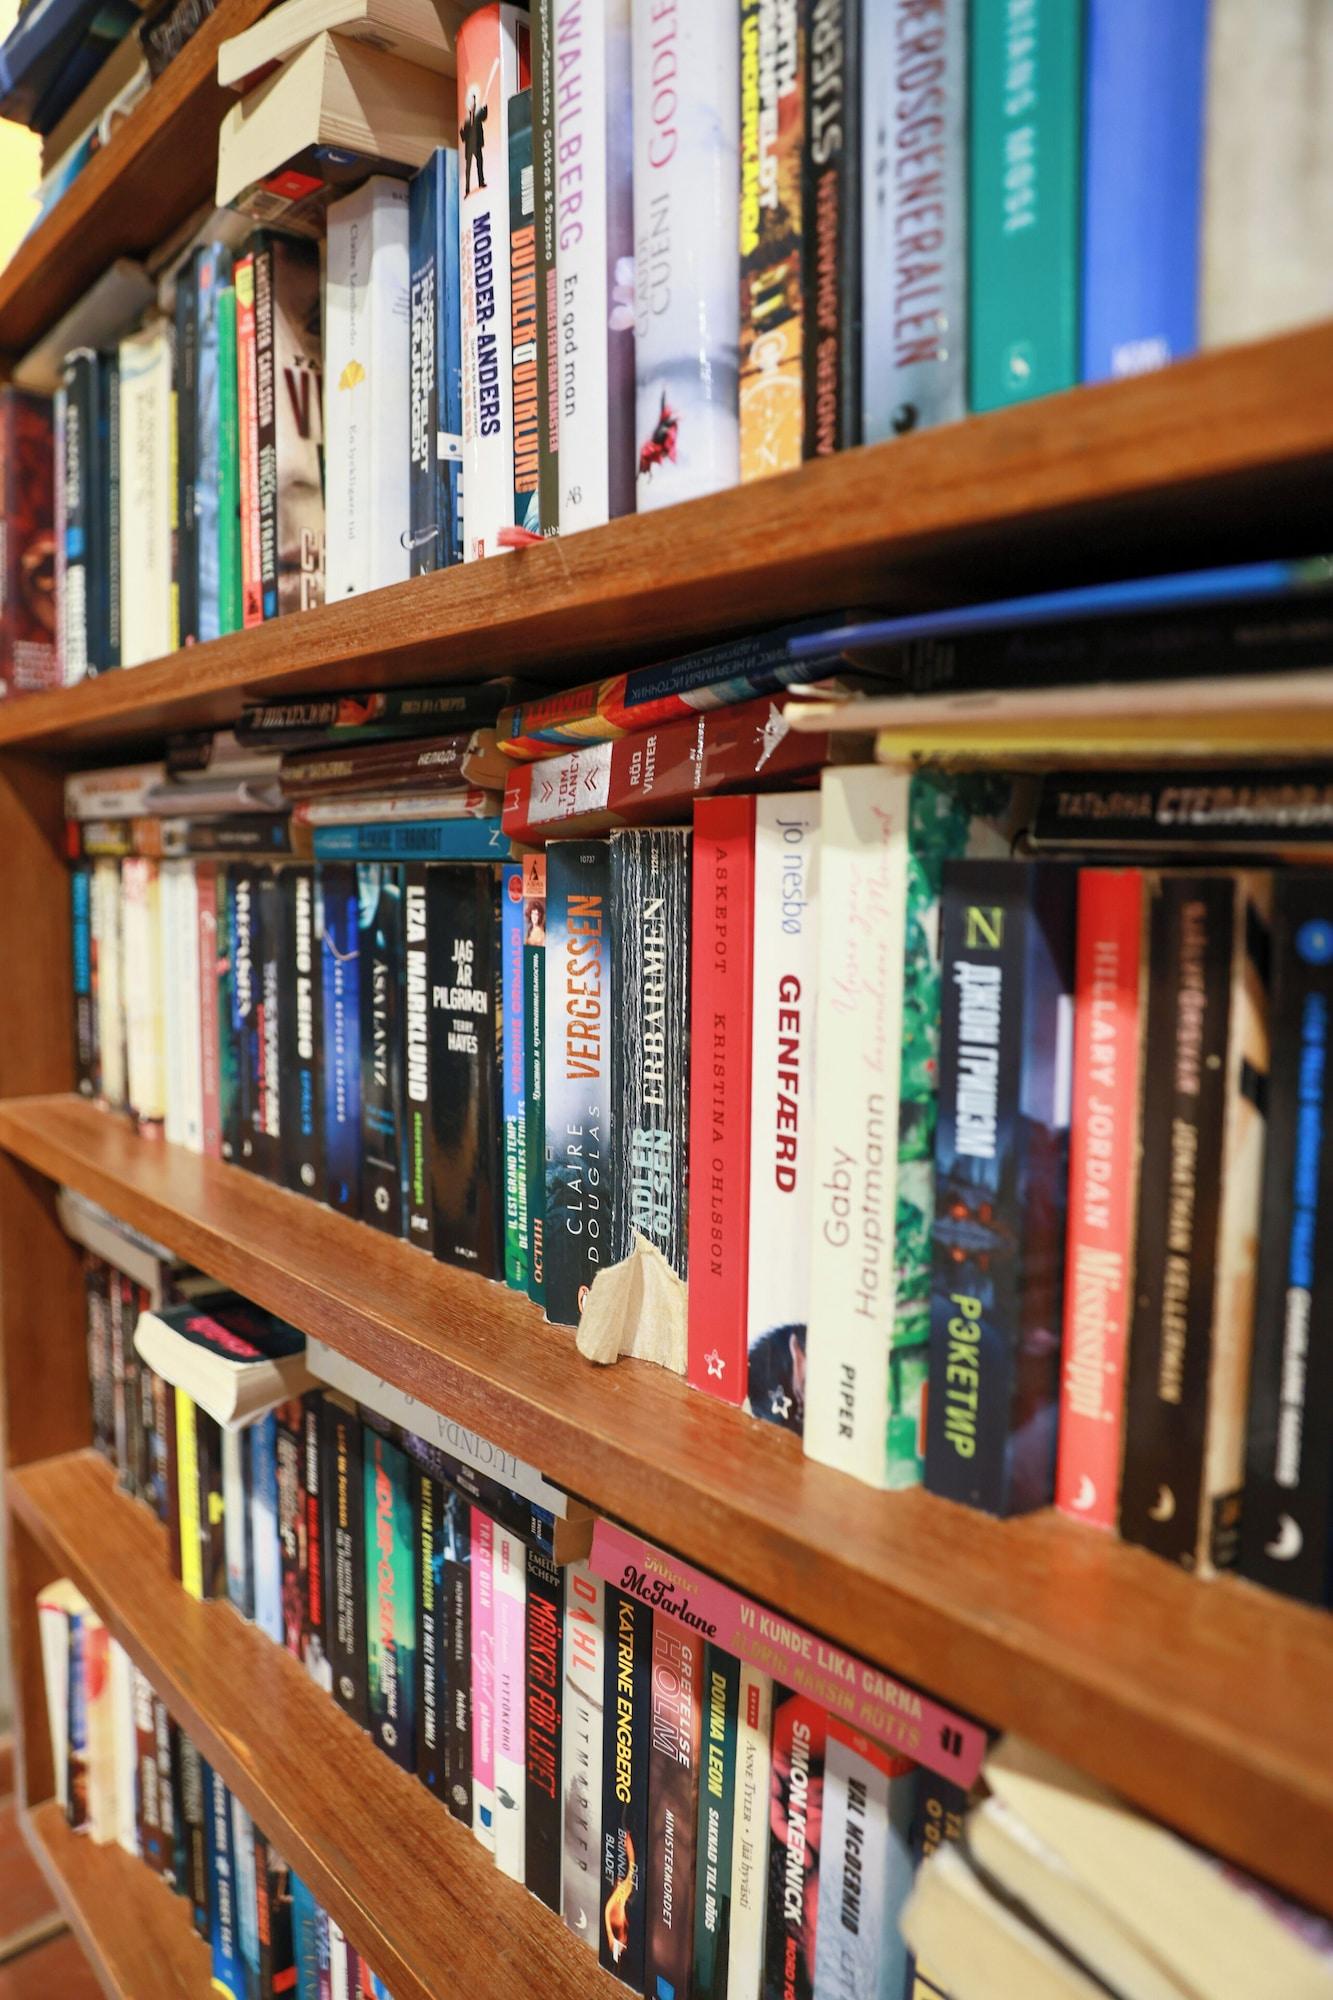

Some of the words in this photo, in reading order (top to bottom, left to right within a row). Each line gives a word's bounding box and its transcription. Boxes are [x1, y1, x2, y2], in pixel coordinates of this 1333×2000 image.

[541, 129, 553, 183] Cotton
[557, 0, 584, 251] WAHLBERG
[542, 203, 554, 261] Torneo
[649, 192, 673, 316] CUENI
[472, 211, 501, 438] MORDER-ANDERS
[562, 273, 578, 306] En
[561, 312, 579, 357] god
[562, 362, 578, 418] man
[557, 768, 570, 806] TOM
[565, 752, 581, 816] CLANCY
[628, 750, 643, 787] RÖD
[641, 734, 659, 796] VINTER
[777, 820, 810, 845] jo
[407, 885, 427, 943] LIZA
[713, 845, 728, 975] ASKEPOT
[781, 854, 809, 936] nesbø
[451, 939, 475, 963] JAG
[565, 894, 605, 1080] VERGESSEN
[297, 977, 313, 1060] LEINO
[408, 950, 428, 1101] MARKLUND
[432, 986, 489, 1014] PILGRIMEN
[452, 1018, 475, 1035] TERRY
[642, 896, 666, 1107] ERBARMEN
[952, 961, 1003, 1043] ДЖОН
[1087, 940, 1120, 1088] HILLARY
[447, 1032, 479, 1055] HAYES
[711, 1012, 726, 1144] KRISTINA
[775, 974, 802, 1194] GENFÆRD
[507, 1114, 518, 1152] TEMPS
[1083, 1094, 1116, 1231] JORDAN
[507, 1152, 518, 1195] GRAND
[507, 1195, 518, 1217] EST
[566, 1122, 583, 1236] CLAIRE
[587, 1103, 601, 1265] DOUGLAS
[630, 1127, 654, 1233] ADLER
[651, 1129, 672, 1238] OLSEN
[822, 1147, 860, 1249] Gaby
[854, 1094, 886, 1319] Hauptmann
[507, 1220, 518, 1231] IL
[517, 1235, 529, 1250] DE
[532, 1217, 544, 1285] ОСТИН
[710, 1157, 725, 1277] OHLSSON
[1065, 1243, 1125, 1425] Mississippi
[838, 1363, 857, 1441] PIPER
[944, 1292, 983, 1459] РЭКЕТИР
[436, 1414, 519, 1480] LUCINDA
[480, 1521, 493, 1568] TRACY
[527, 1561, 561, 1587] SCHEPP
[528, 1549, 560, 1577] EMELIE
[480, 1570, 492, 1609] QUAN
[619, 1563, 719, 1639] McFarlane
[454, 1617, 465, 1662] RUSSELL
[616, 1599, 635, 1698] KATRINE
[739, 1603, 756, 1627] VI
[759, 1608, 813, 1660] KUNDE
[817, 1642, 858, 1686] LIKA
[862, 1663, 925, 1723] GÄRNA
[501, 1673, 512, 1753] TYTTÖKERHO
[528, 1682, 562, 1736] FÖR
[652, 1629, 682, 1761] HOLM
[679, 1644, 694, 1769] GRETELISE
[709, 1671, 728, 1743] DONNA
[528, 1727, 557, 1799] LIVET
[615, 1695, 635, 1804] ENGBERG
[708, 1742, 724, 1799] LEON
[787, 1718, 811, 1803] SIMON
[575, 1706, 590, 1873] UTMARKER
[846, 1777, 868, 1816] VAL
[604, 1832, 616, 1887] BLADET
[662, 1807, 676, 1929] MINISTERMORDET
[707, 1806, 721, 1863] SAKNAD
[783, 1809, 808, 1926] KERNICK
[628, 1861, 639, 1891] DET
[705, 1863, 719, 1891] TILL
[738, 1863, 754, 1911] hyvästi
[840, 1820, 865, 1936] McDERMID
[704, 1892, 719, 1933] DÖDS
[784, 1935, 798, 1980] MORD
